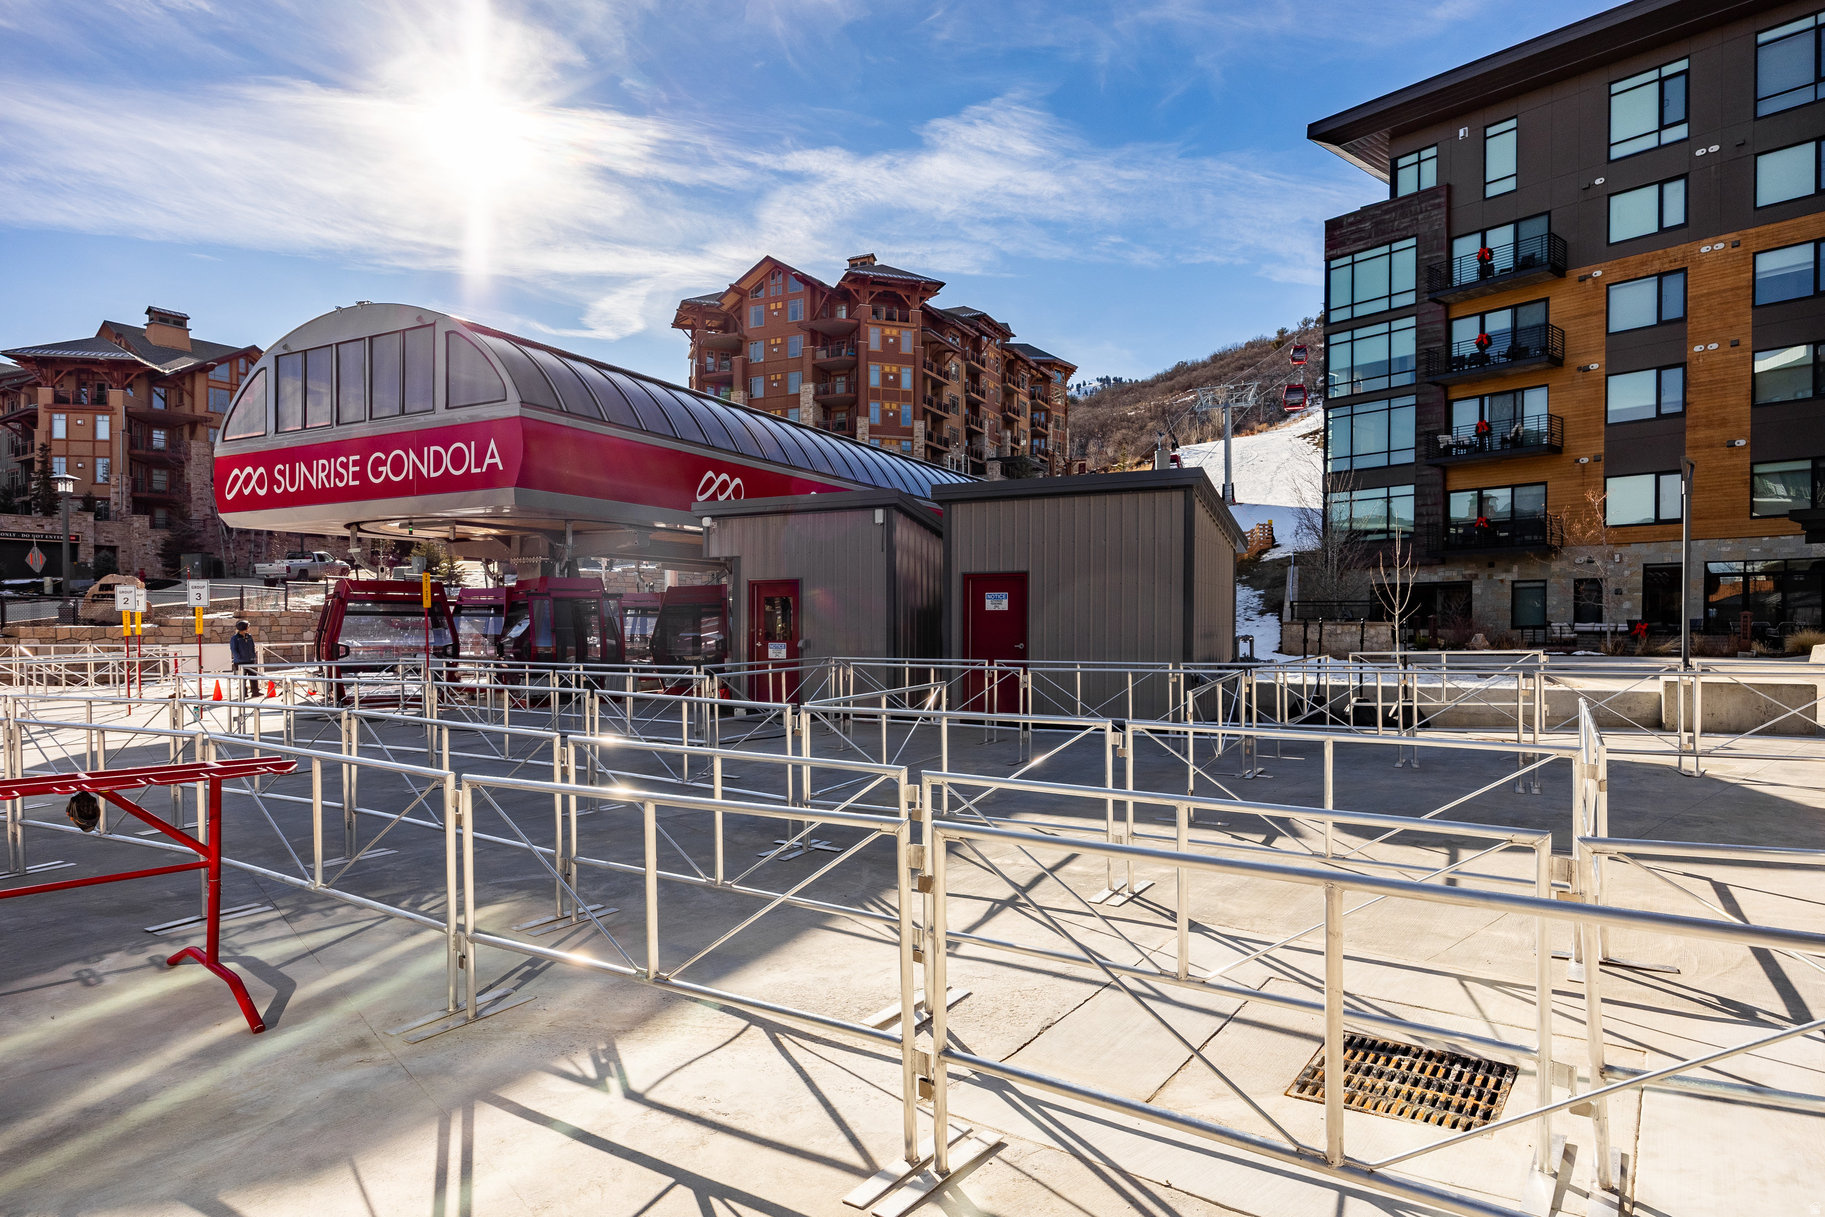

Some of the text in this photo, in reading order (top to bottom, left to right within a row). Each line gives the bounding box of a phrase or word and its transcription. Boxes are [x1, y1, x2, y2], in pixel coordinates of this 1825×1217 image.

[273, 437, 504, 494] SUNRISE GONDOLA
[195, 592, 202, 601] 3
[123, 597, 129, 605] 2
[136, 599, 140, 607] 1
